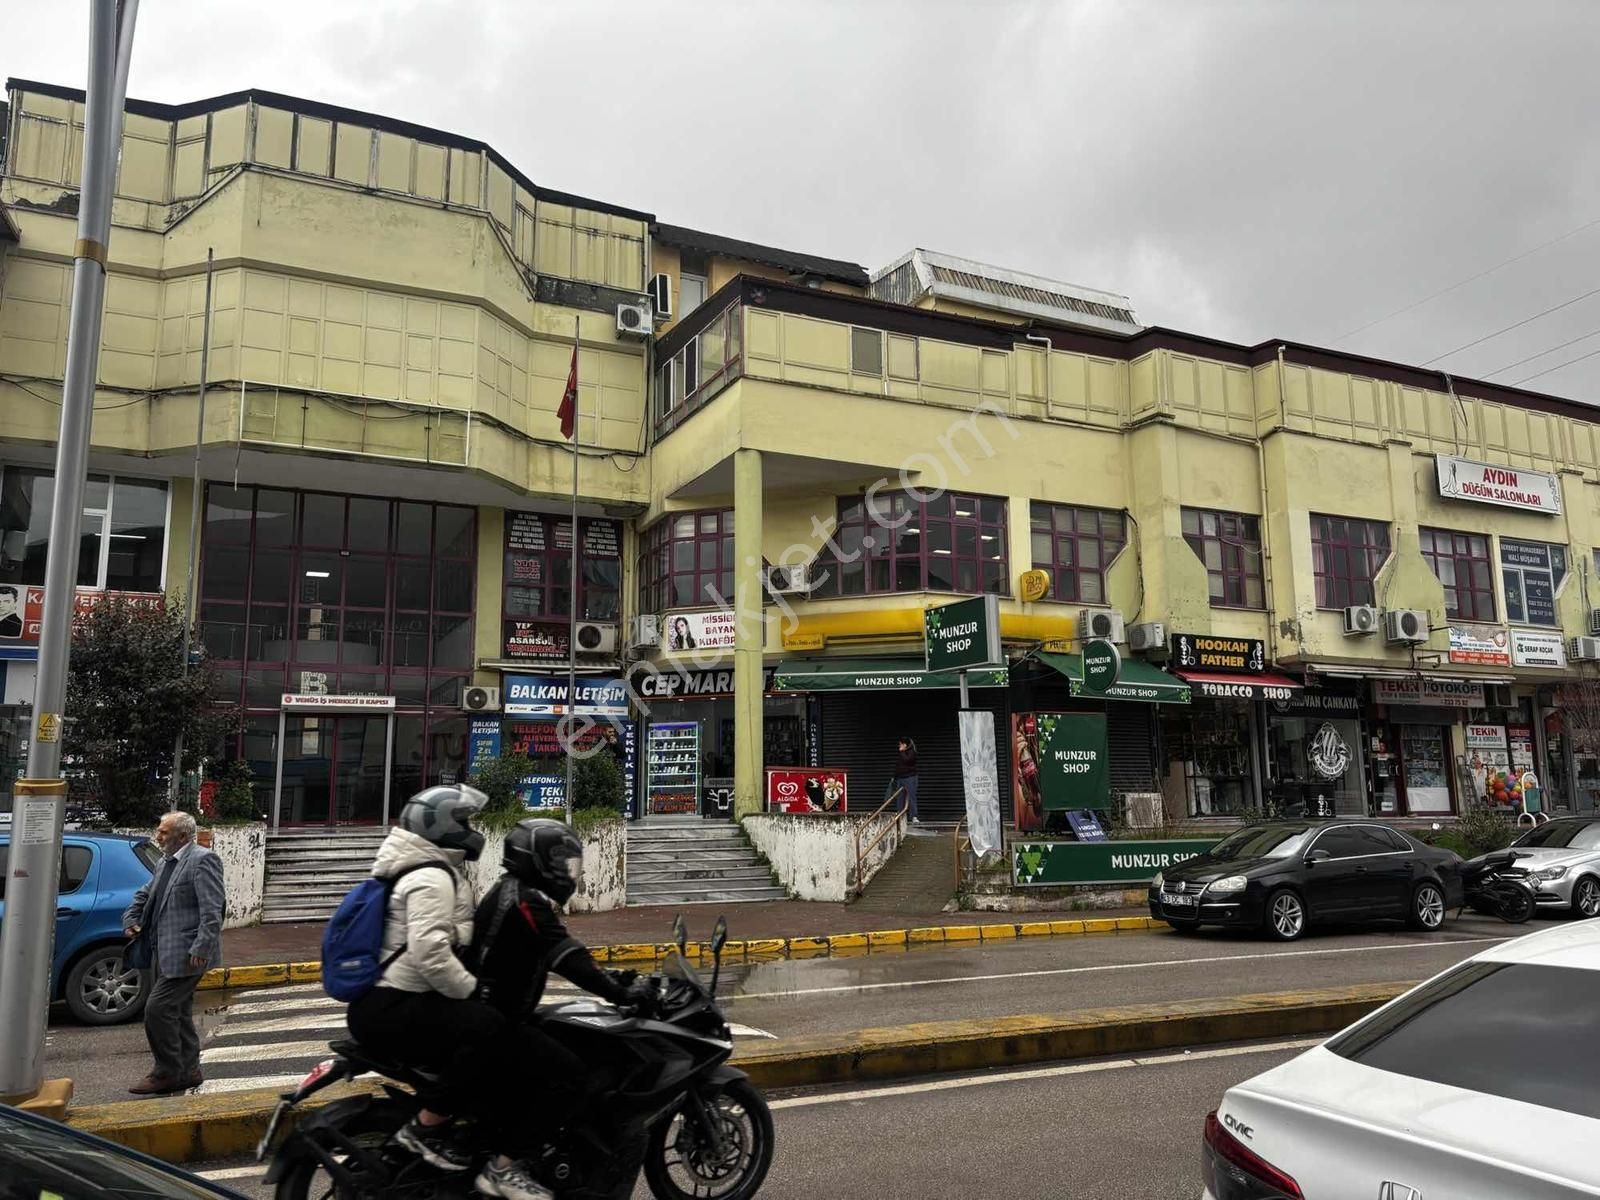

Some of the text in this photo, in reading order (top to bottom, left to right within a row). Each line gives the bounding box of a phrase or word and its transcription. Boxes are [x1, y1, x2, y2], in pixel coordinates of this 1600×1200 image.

[1482, 468, 1518, 488] AYDIN
[1462, 482, 1542, 506] DÜĞÜN SALONLARI
[705, 626, 736, 635] BAYAN
[940, 622, 978, 640] MUNZUR
[946, 638, 972, 654] SHOP
[1196, 639, 1248, 653] HOOKAH
[1086, 656, 1111, 666] MUNZUR
[1201, 654, 1245, 667] FATHER
[640, 670, 773, 698] CEP MART
[856, 676, 922, 686] MUNZUR SHOP
[510, 684, 626, 704] BALKAN LETİŞİM
[1138, 689, 1158, 697] SHOP
[1202, 683, 1292, 700] TOBACCO SHOP
[1054, 751, 1096, 760] MUNZUR
[1063, 763, 1090, 774] SHOP
[1112, 854, 1170, 868] MUNZUR
